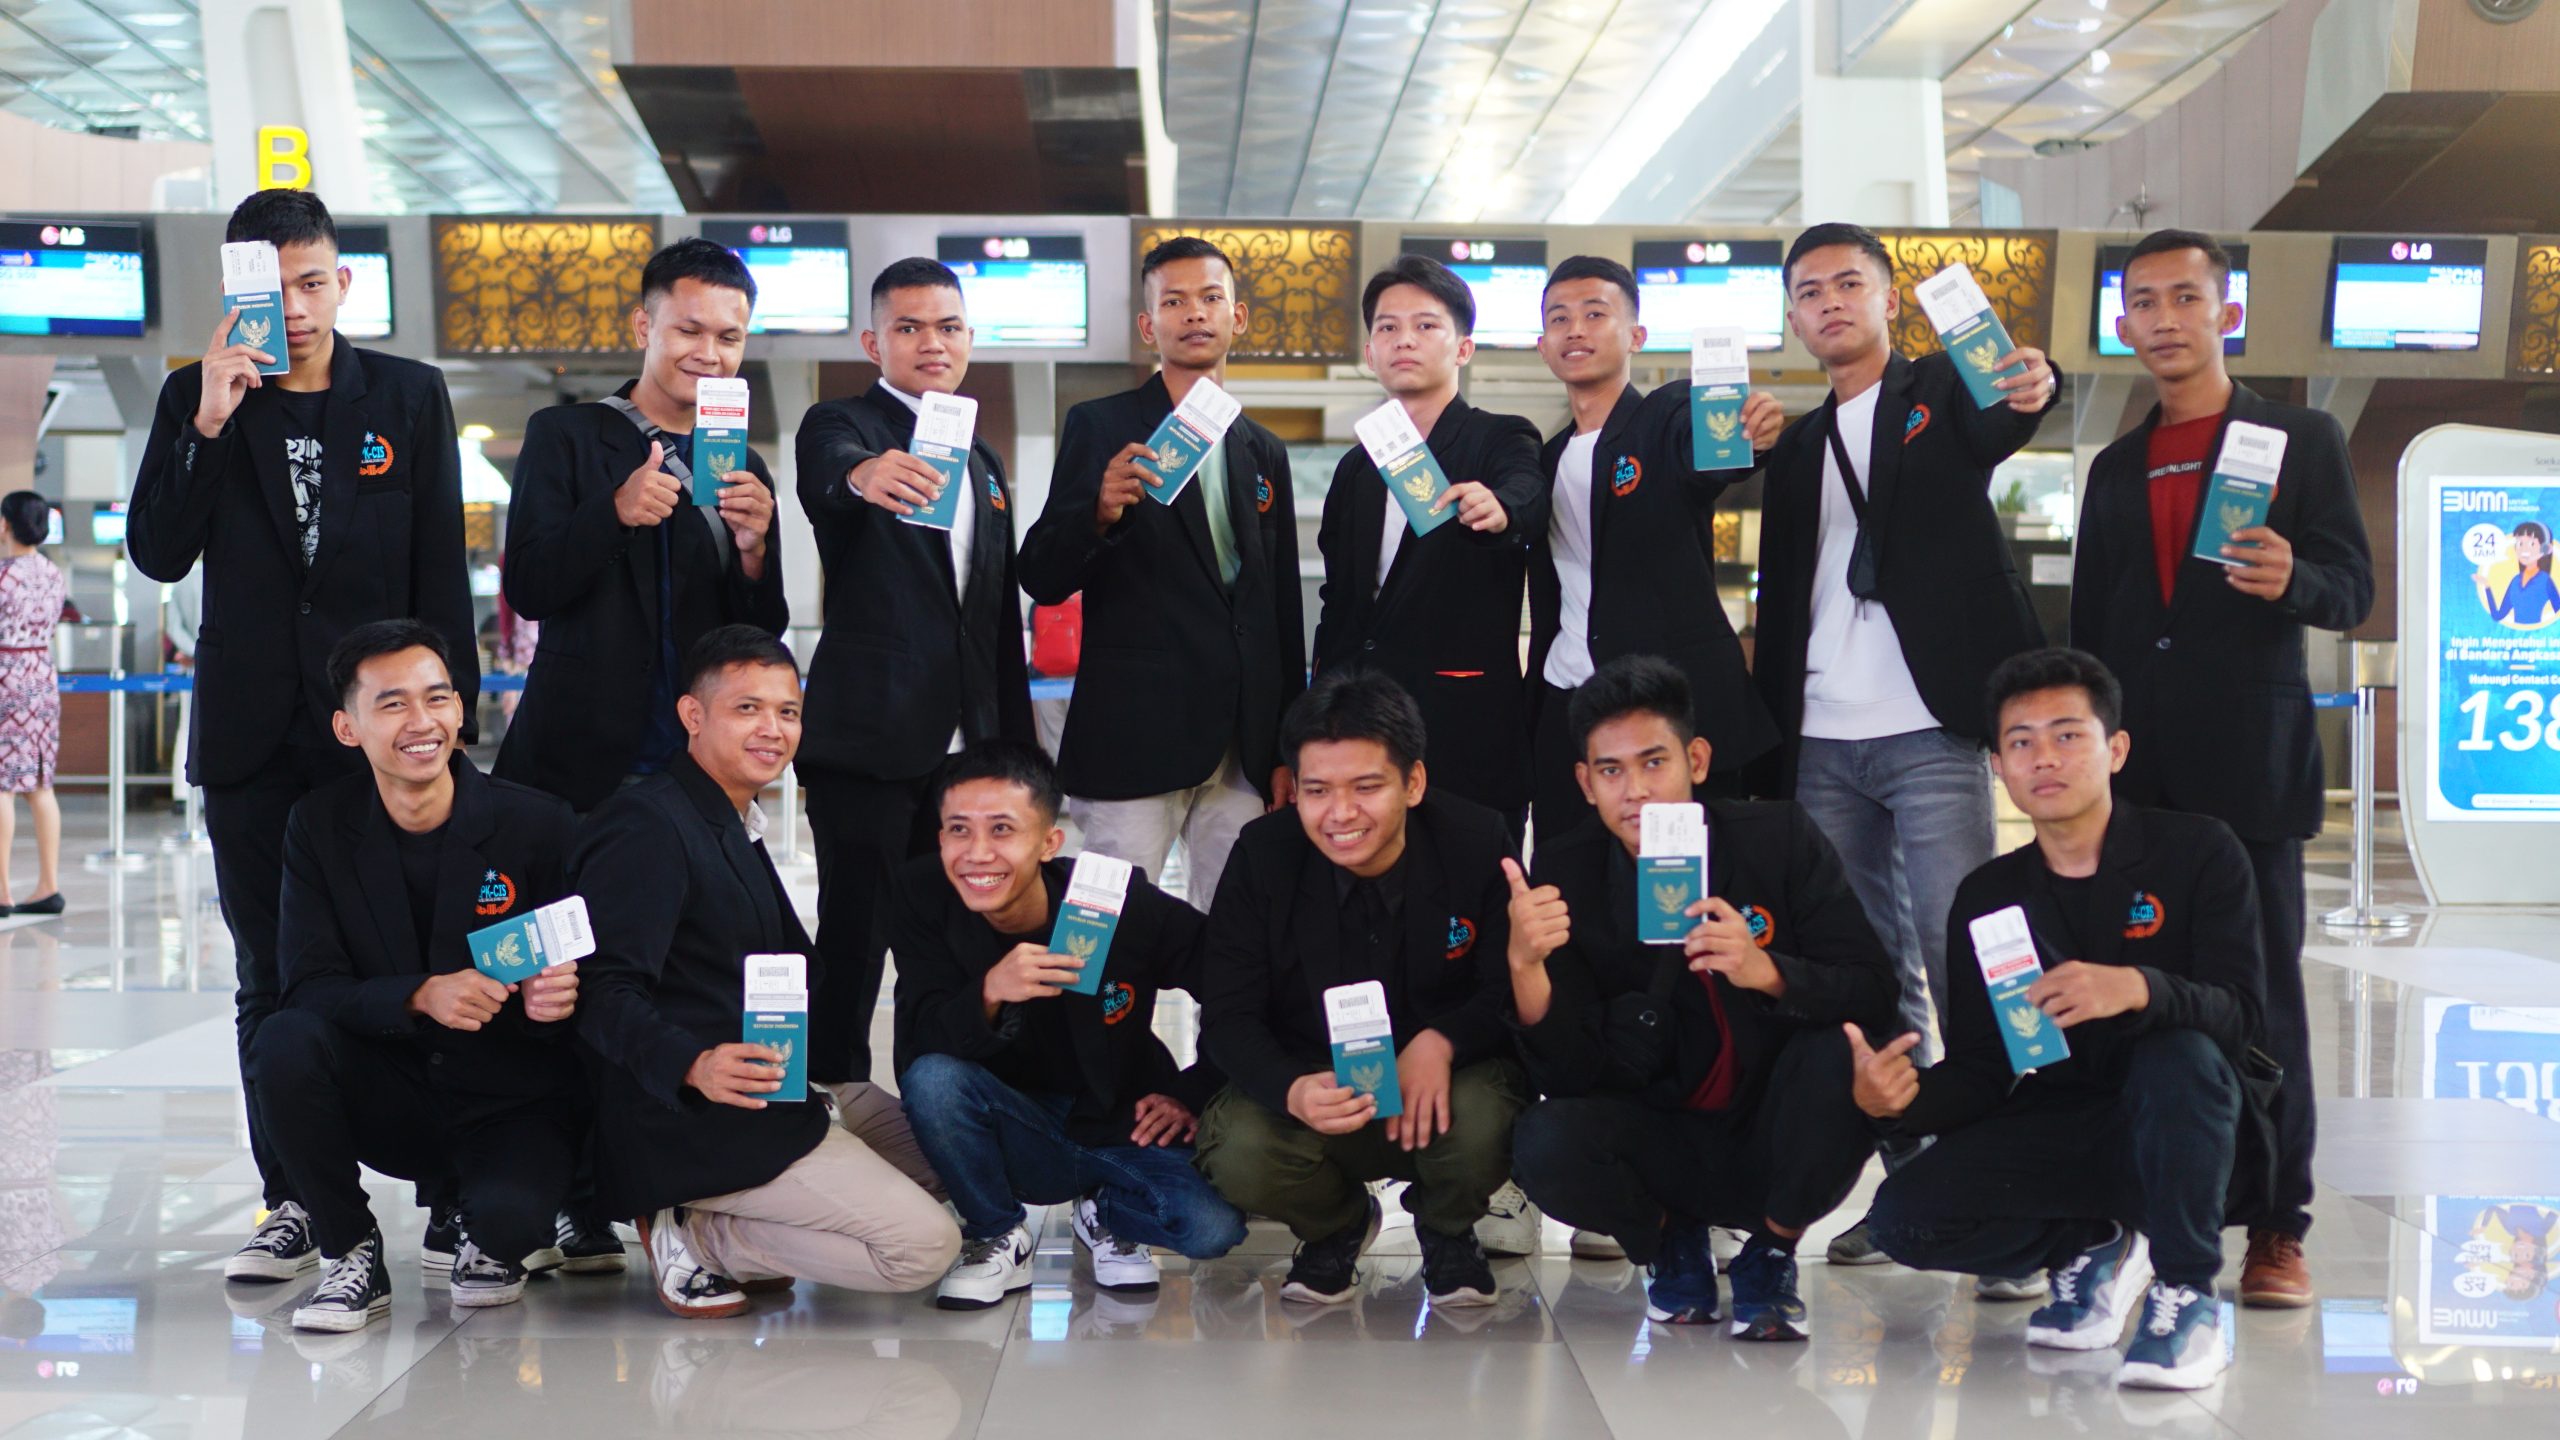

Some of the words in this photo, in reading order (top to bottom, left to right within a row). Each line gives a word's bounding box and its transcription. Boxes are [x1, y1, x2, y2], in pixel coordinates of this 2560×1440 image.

[258, 125, 312, 191] B
[768, 225, 793, 243] LG
[2410, 242, 2433, 261] LG
[2443, 490, 2509, 512] BUMN
[2473, 532, 2495, 548] 24
[2451, 636, 2480, 649] Ingin
[2482, 636, 2547, 650] Mengetahui
[2445, 648, 2458, 661] di
[2459, 648, 2510, 661] Bandara
[2469, 674, 2511, 686] Hubungi
[2512, 674, 2549, 685] Contact
